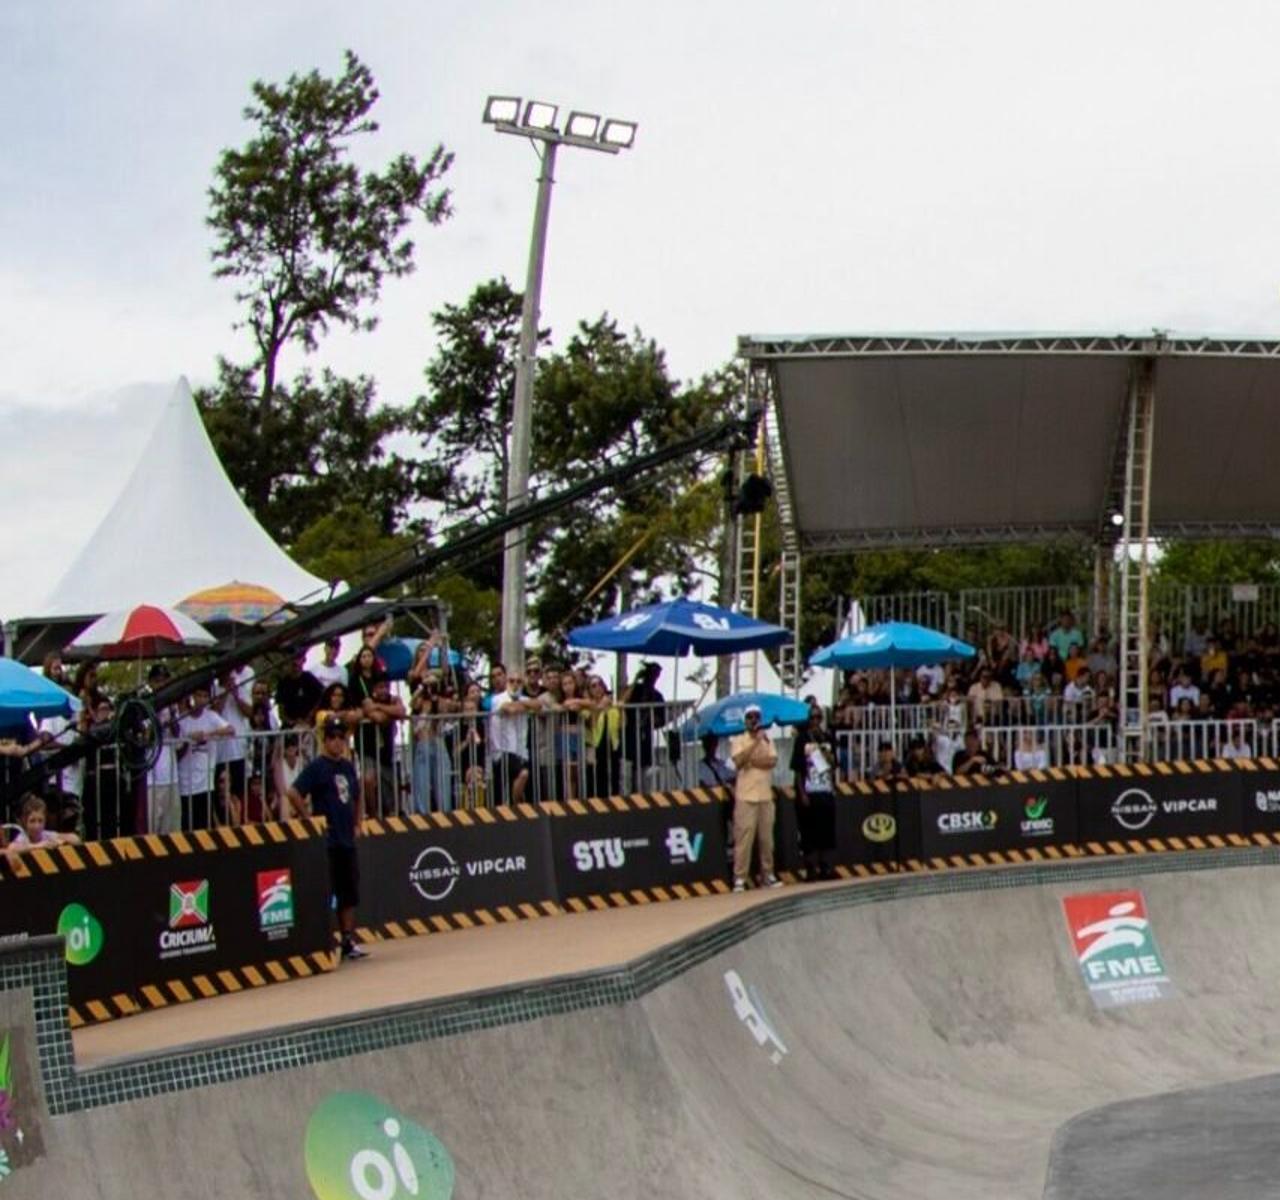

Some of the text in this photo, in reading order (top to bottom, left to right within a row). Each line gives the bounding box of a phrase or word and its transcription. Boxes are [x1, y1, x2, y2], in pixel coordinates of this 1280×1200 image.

[1162, 798, 1218, 813] VIPCAR
[936, 811, 983, 831] CBSK
[573, 838, 625, 871] STU
[409, 856, 526, 881] NISSAN VIPCAR
[261, 909, 292, 926] FME
[70, 916, 90, 950] oi
[1086, 955, 1162, 980] FME
